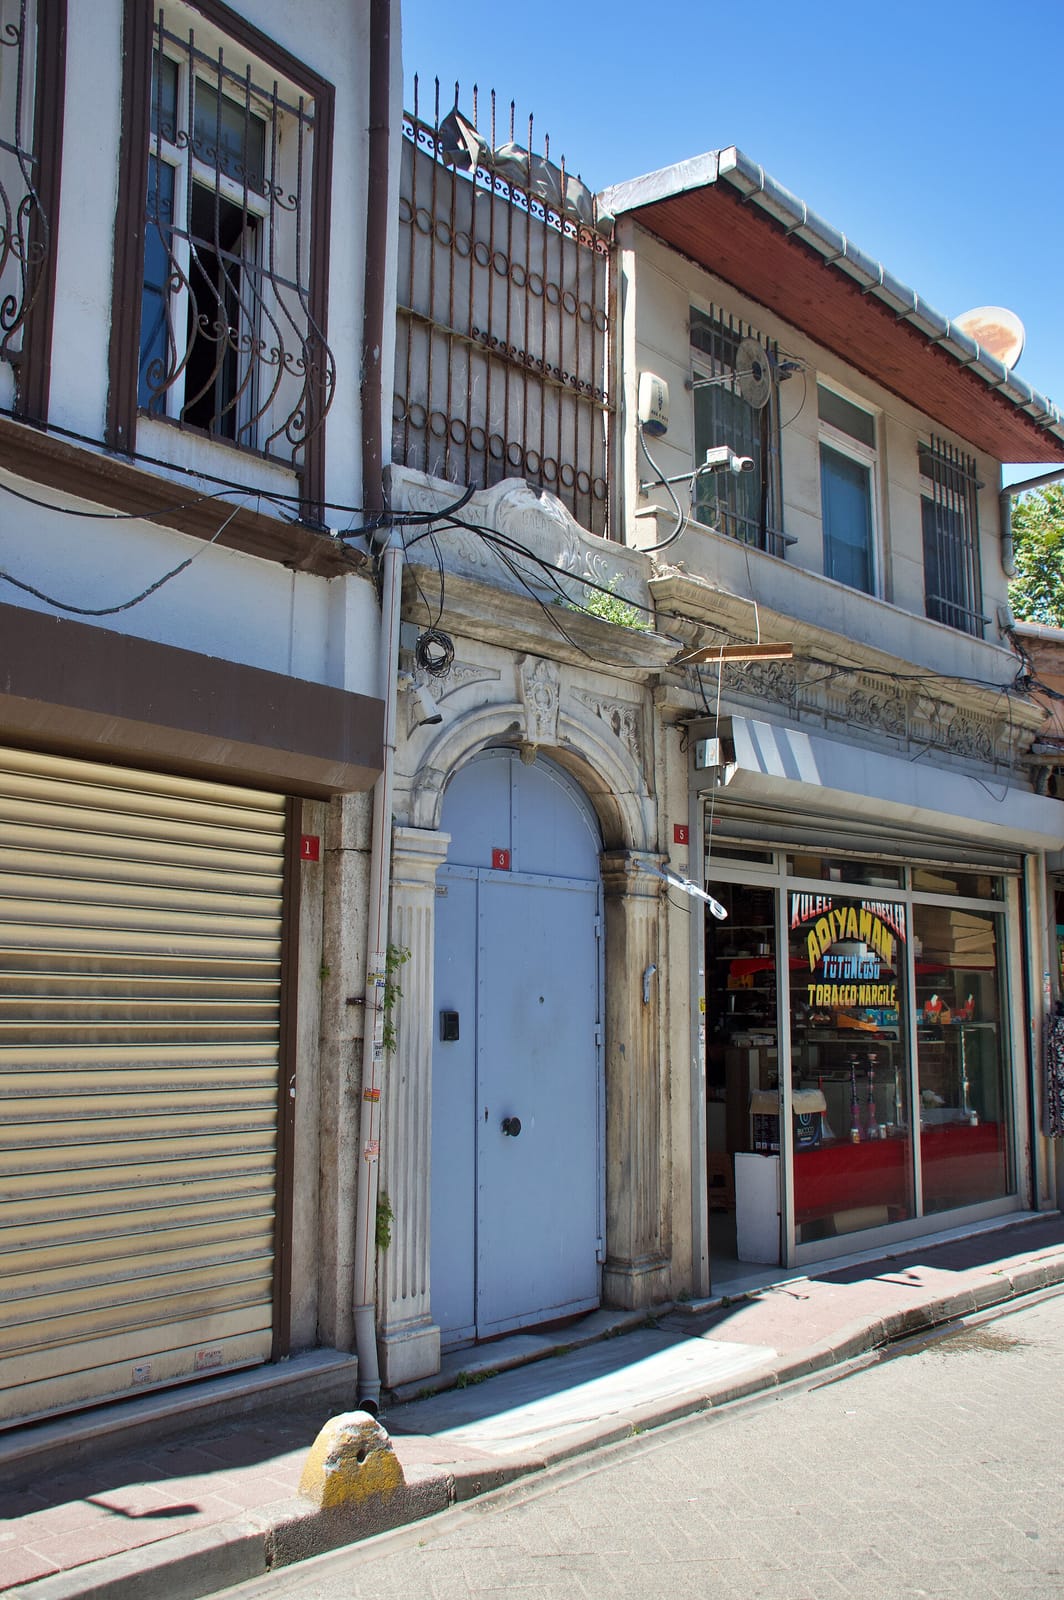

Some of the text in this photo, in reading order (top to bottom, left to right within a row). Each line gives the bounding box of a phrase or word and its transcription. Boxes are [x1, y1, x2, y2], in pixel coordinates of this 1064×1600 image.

[679, 830, 685, 840] 5
[304, 841, 310, 854] 1
[499, 854, 505, 865] 3
[807, 907, 893, 973] ADIYAMAN
